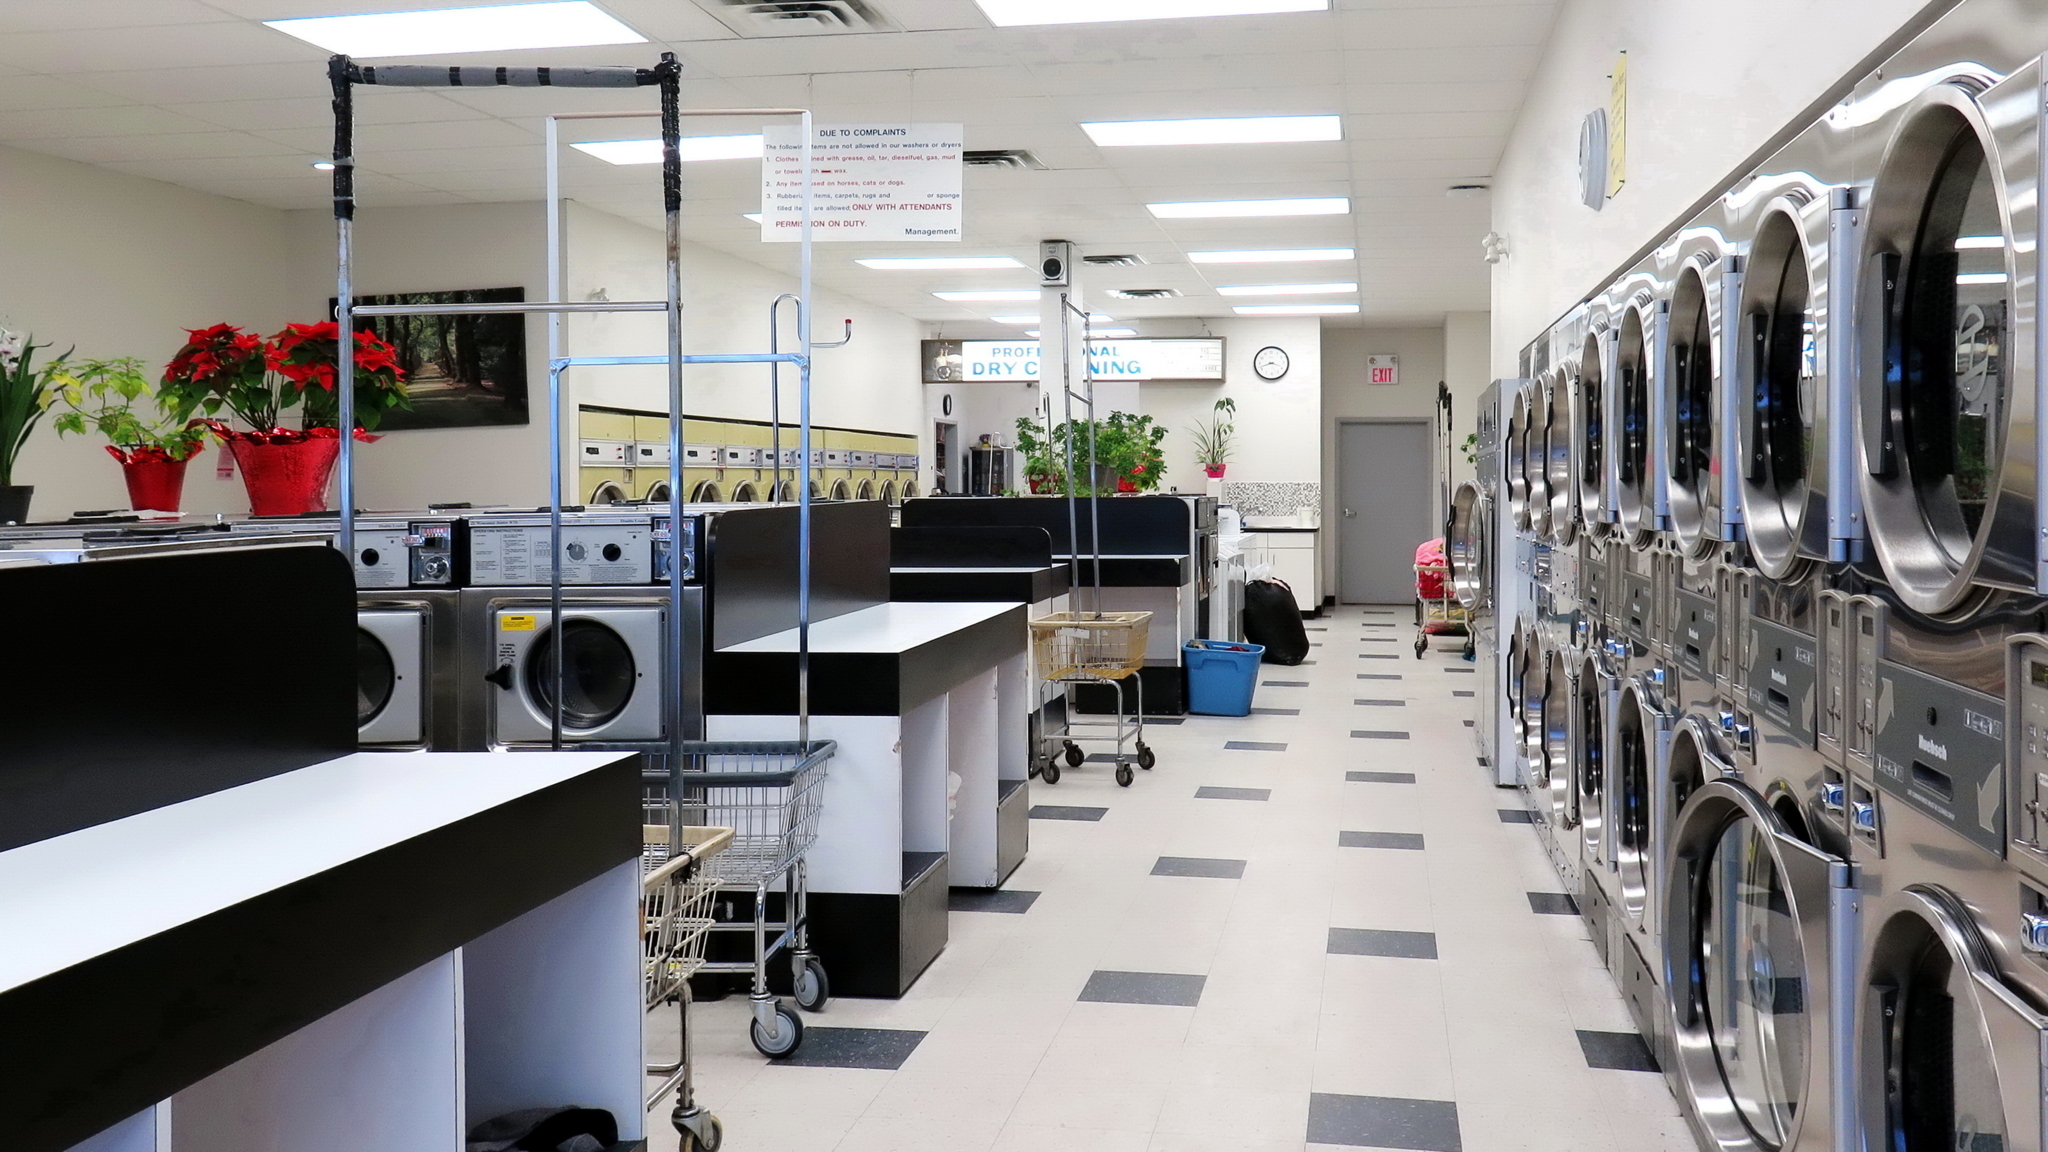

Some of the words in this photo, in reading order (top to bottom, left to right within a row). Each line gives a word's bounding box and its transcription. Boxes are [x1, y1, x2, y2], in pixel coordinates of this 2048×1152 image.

[819, 129, 837, 137] DUE
[839, 129, 851, 137] TO
[853, 128, 907, 137] COMPLAINTS
[898, 203, 953, 211] ATTENDANTS
[904, 228, 959, 236] Management.
[972, 361, 1018, 376] DRY
[1024, 360, 1141, 375] CNING
[1373, 368, 1393, 382] EXIT
